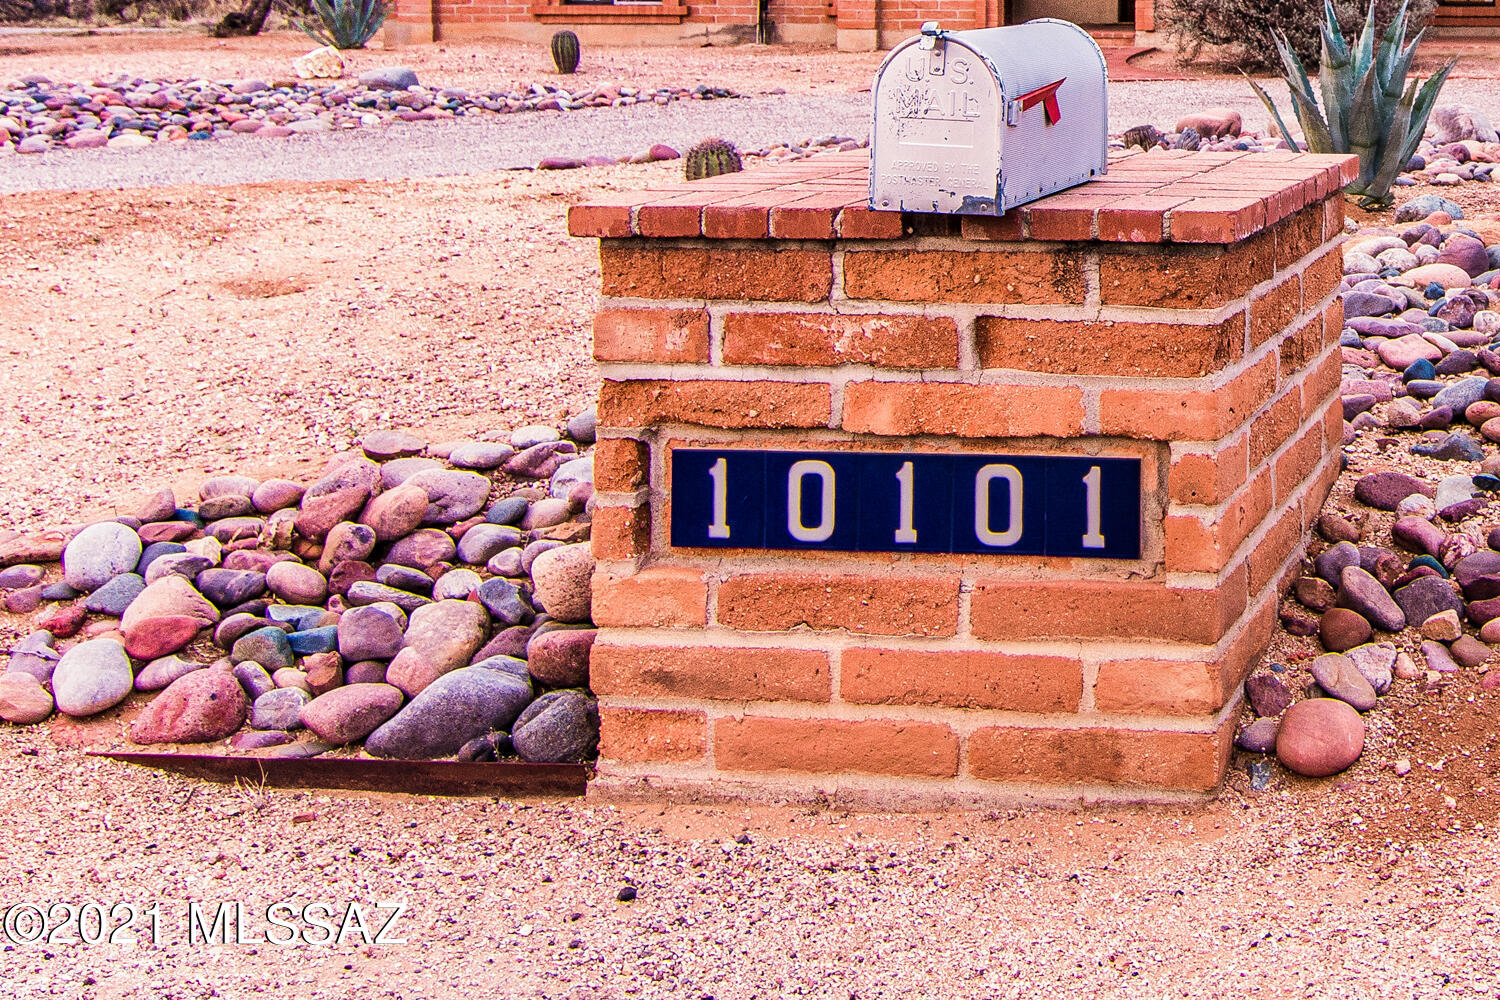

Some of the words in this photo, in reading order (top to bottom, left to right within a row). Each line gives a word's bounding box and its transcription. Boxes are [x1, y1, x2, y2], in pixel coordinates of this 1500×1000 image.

[896, 87, 981, 118] MAIL
[891, 160, 938, 172] APPROVED
[944, 162, 955, 173] BY
[960, 162, 981, 175] THE
[880, 174, 941, 187] POSTMASTER
[946, 176, 990, 190] GENERAL
[707, 457, 1105, 549] 10101
